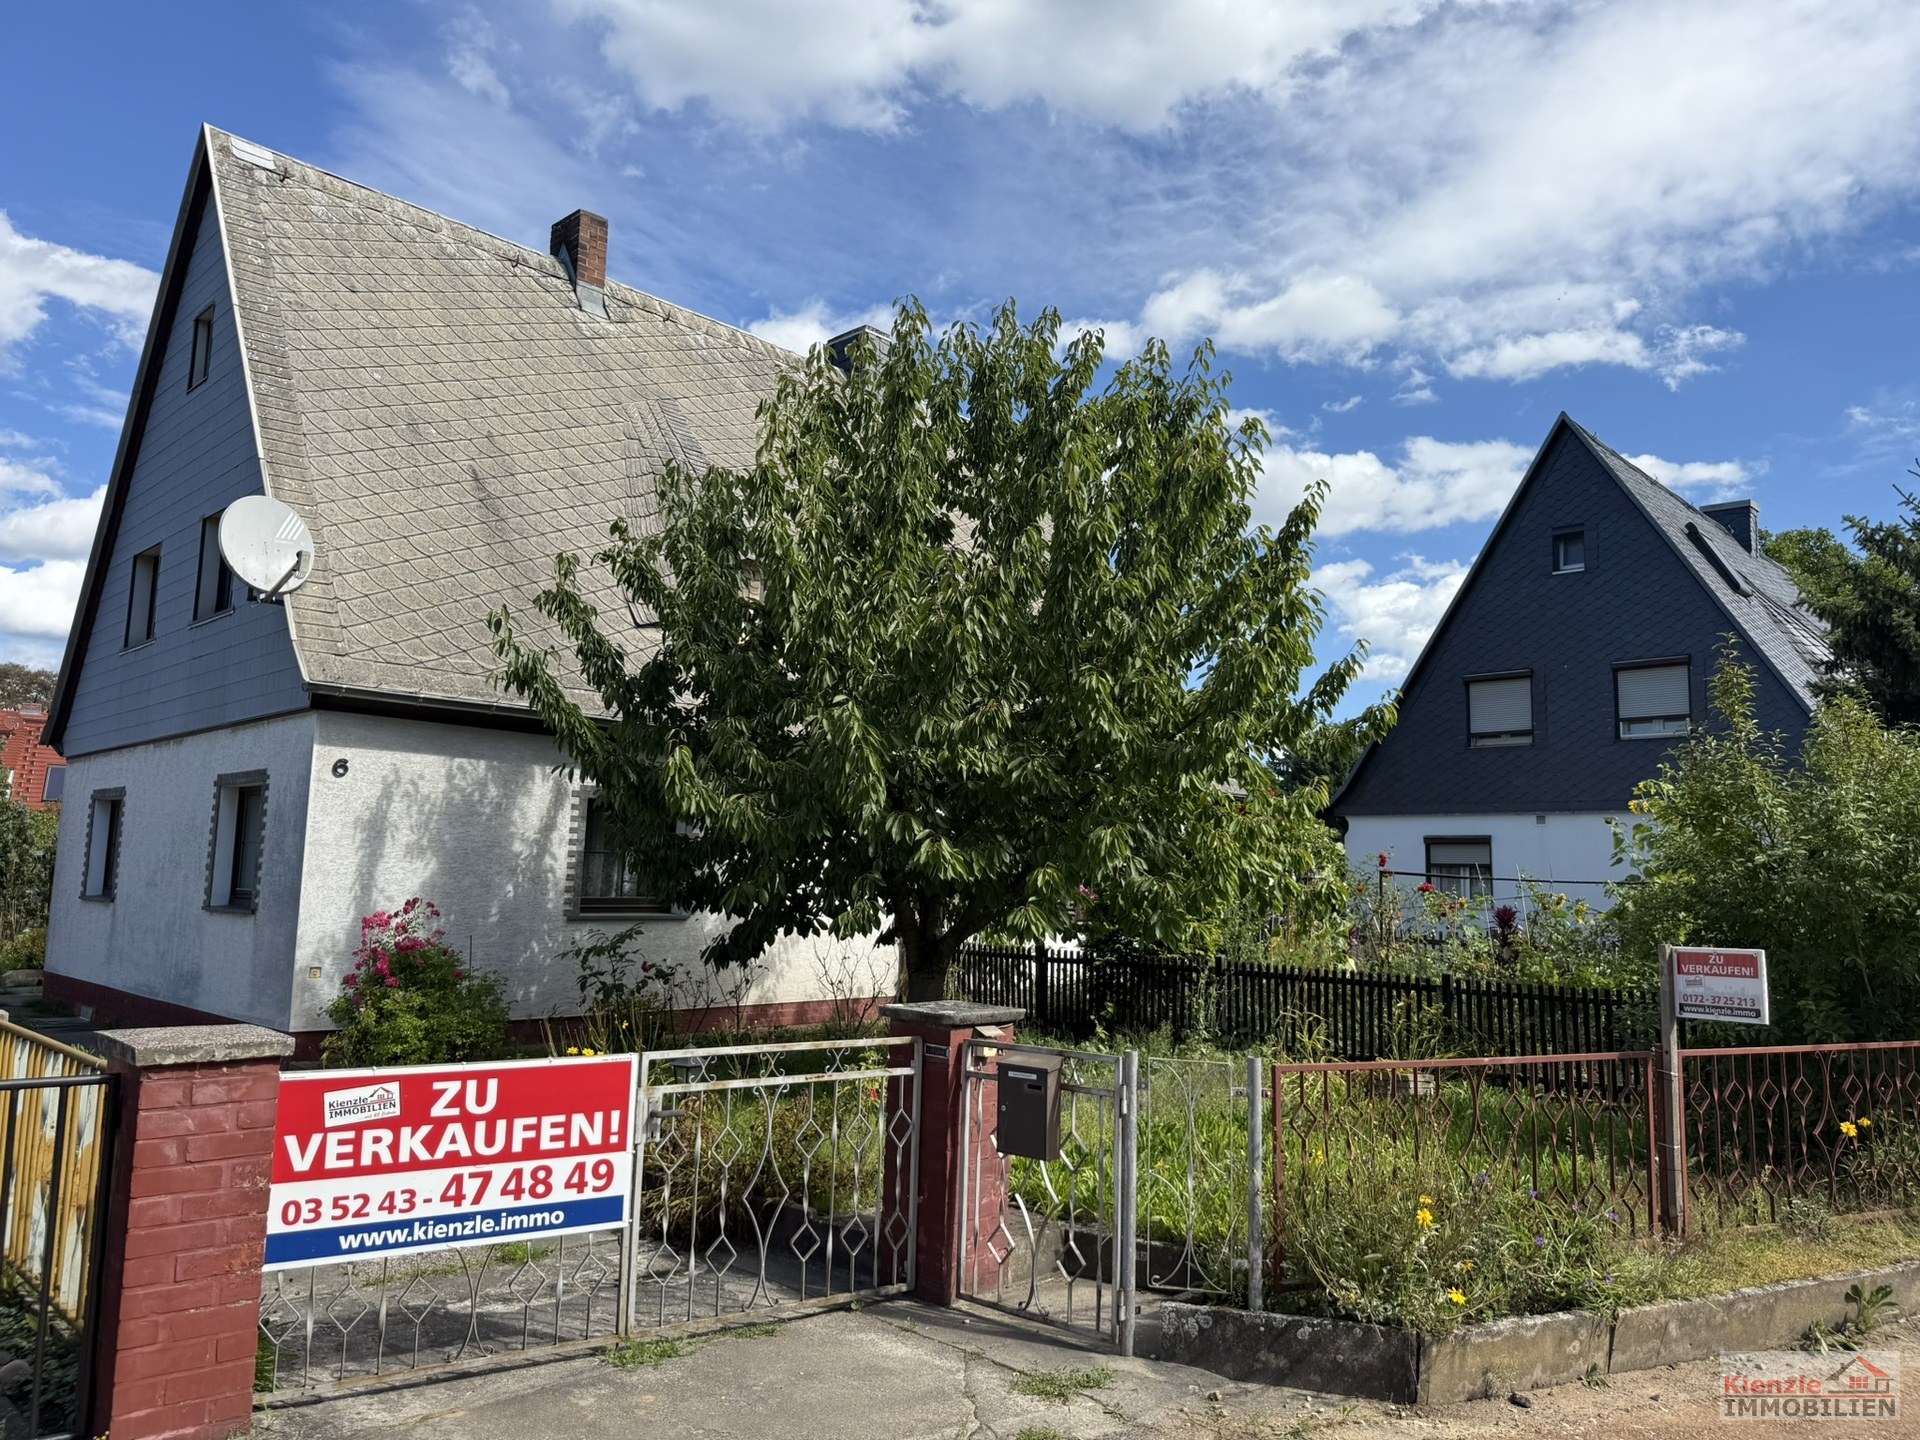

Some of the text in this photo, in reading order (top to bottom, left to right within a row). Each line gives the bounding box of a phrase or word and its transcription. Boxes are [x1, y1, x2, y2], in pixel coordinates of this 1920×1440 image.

[331, 758, 349, 778] 6
[1708, 955, 1724, 964] ZU
[1681, 964, 1754, 976] VERKAUFEN!
[1682, 993, 1705, 1004] 0172
[1683, 1005, 1756, 1017] www.kienzle.immo
[328, 1096, 369, 1109] Kienzle
[430, 1077, 499, 1118] ZU
[329, 1101, 397, 1119] IMMOBILIEN
[283, 1109, 621, 1172] VERKAUFEN!
[281, 1197, 323, 1226] 03
[331, 1193, 371, 1221] 52
[500, 1164, 553, 1201] 48
[564, 1158, 615, 1194] 49
[338, 1210, 565, 1250] www.kienzle.immo
